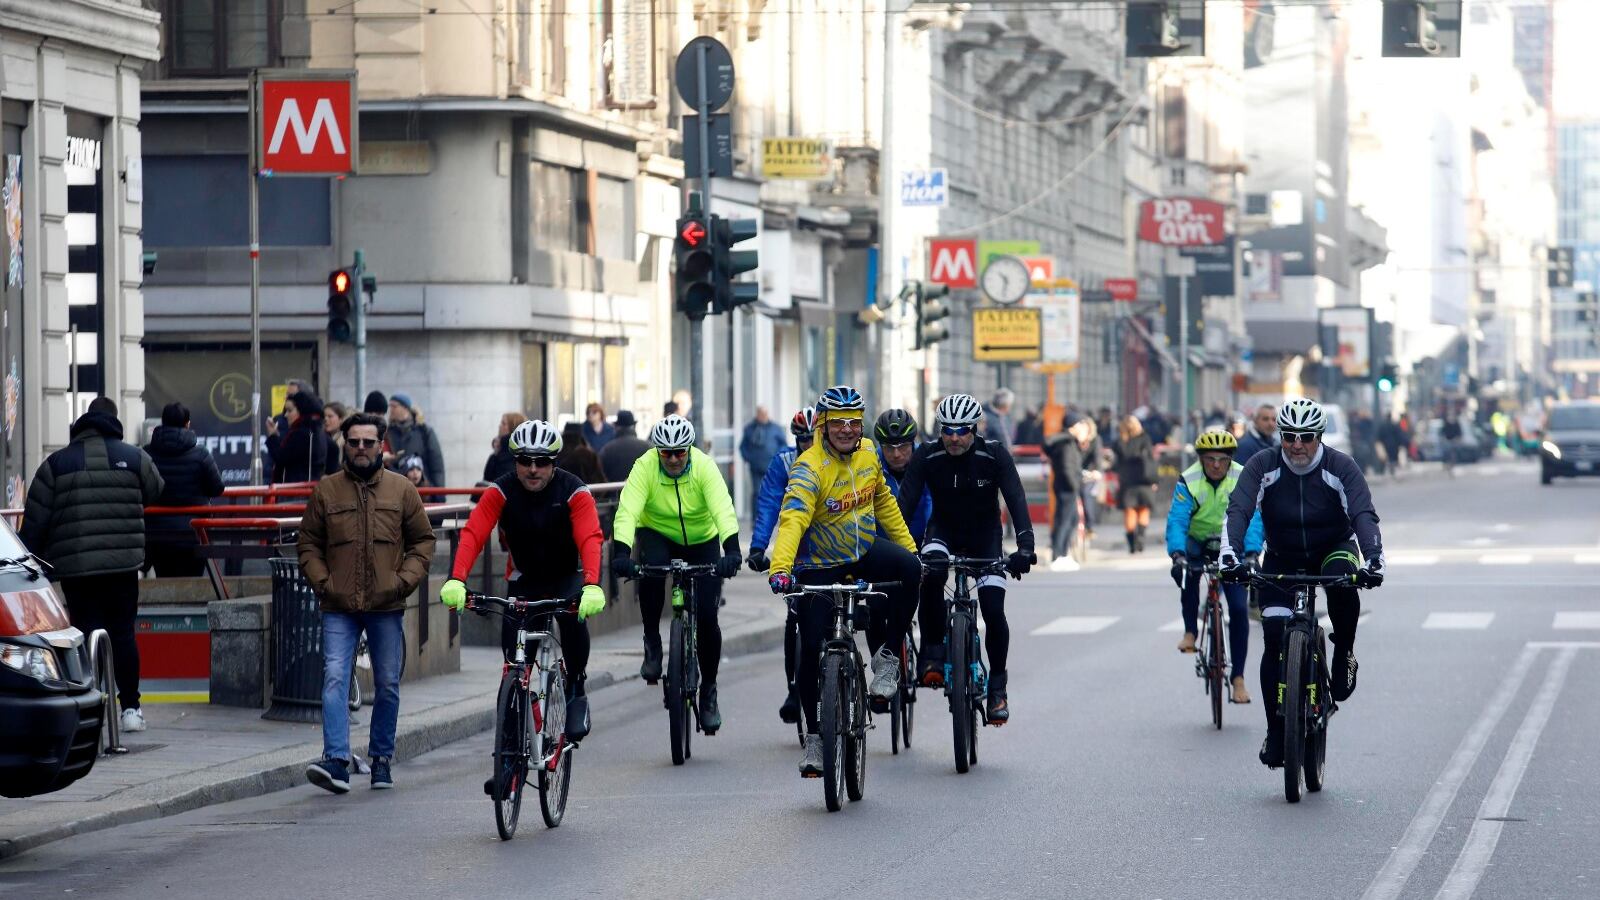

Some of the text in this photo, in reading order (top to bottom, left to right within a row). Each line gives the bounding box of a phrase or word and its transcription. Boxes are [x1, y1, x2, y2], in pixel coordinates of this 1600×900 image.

[267, 97, 347, 155] M
[763, 140, 829, 156] TATTOO
[931, 247, 976, 280] M
[976, 310, 1040, 322] TATTOO
